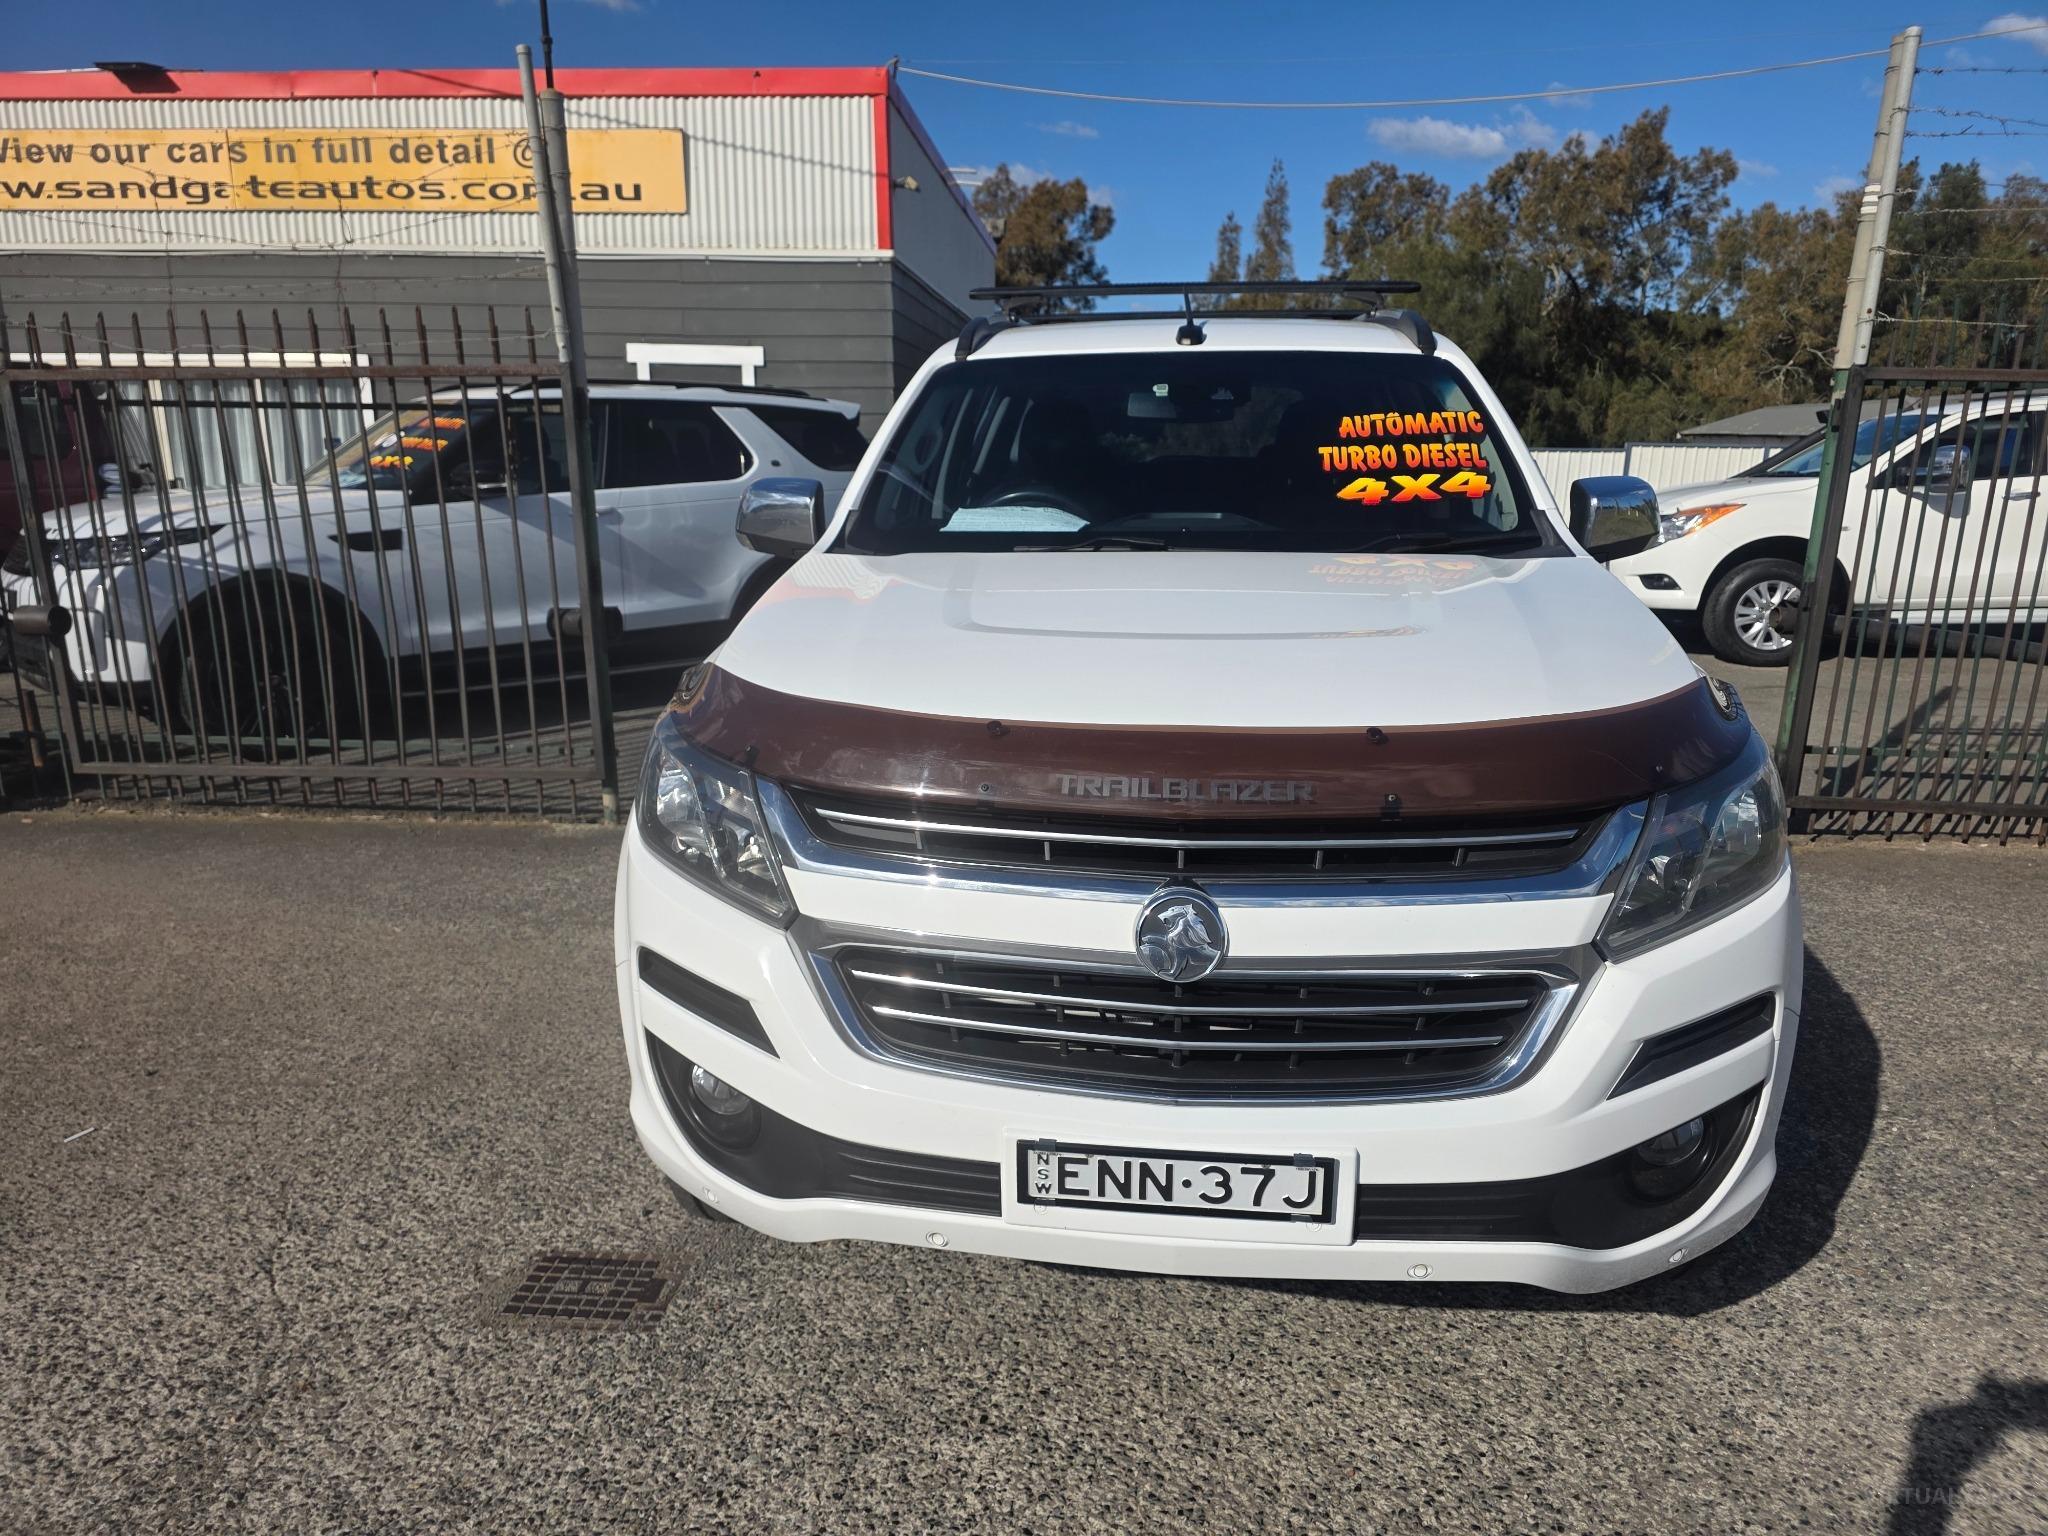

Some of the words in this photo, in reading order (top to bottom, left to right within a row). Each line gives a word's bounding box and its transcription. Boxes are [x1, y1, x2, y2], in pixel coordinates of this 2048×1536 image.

[90, 142, 151, 164] our
[167, 142, 248, 164] cars
[264, 136, 297, 163] in
[312, 136, 373, 164] full
[389, 136, 496, 164] detail
[1338, 410, 1484, 438] AUTOMATIC
[1318, 444, 1399, 472] TURBO
[1402, 442, 1487, 468] DIESEL
[1336, 471, 1492, 505] 4X4
[1055, 773, 1315, 802] TRAILBLAZER
